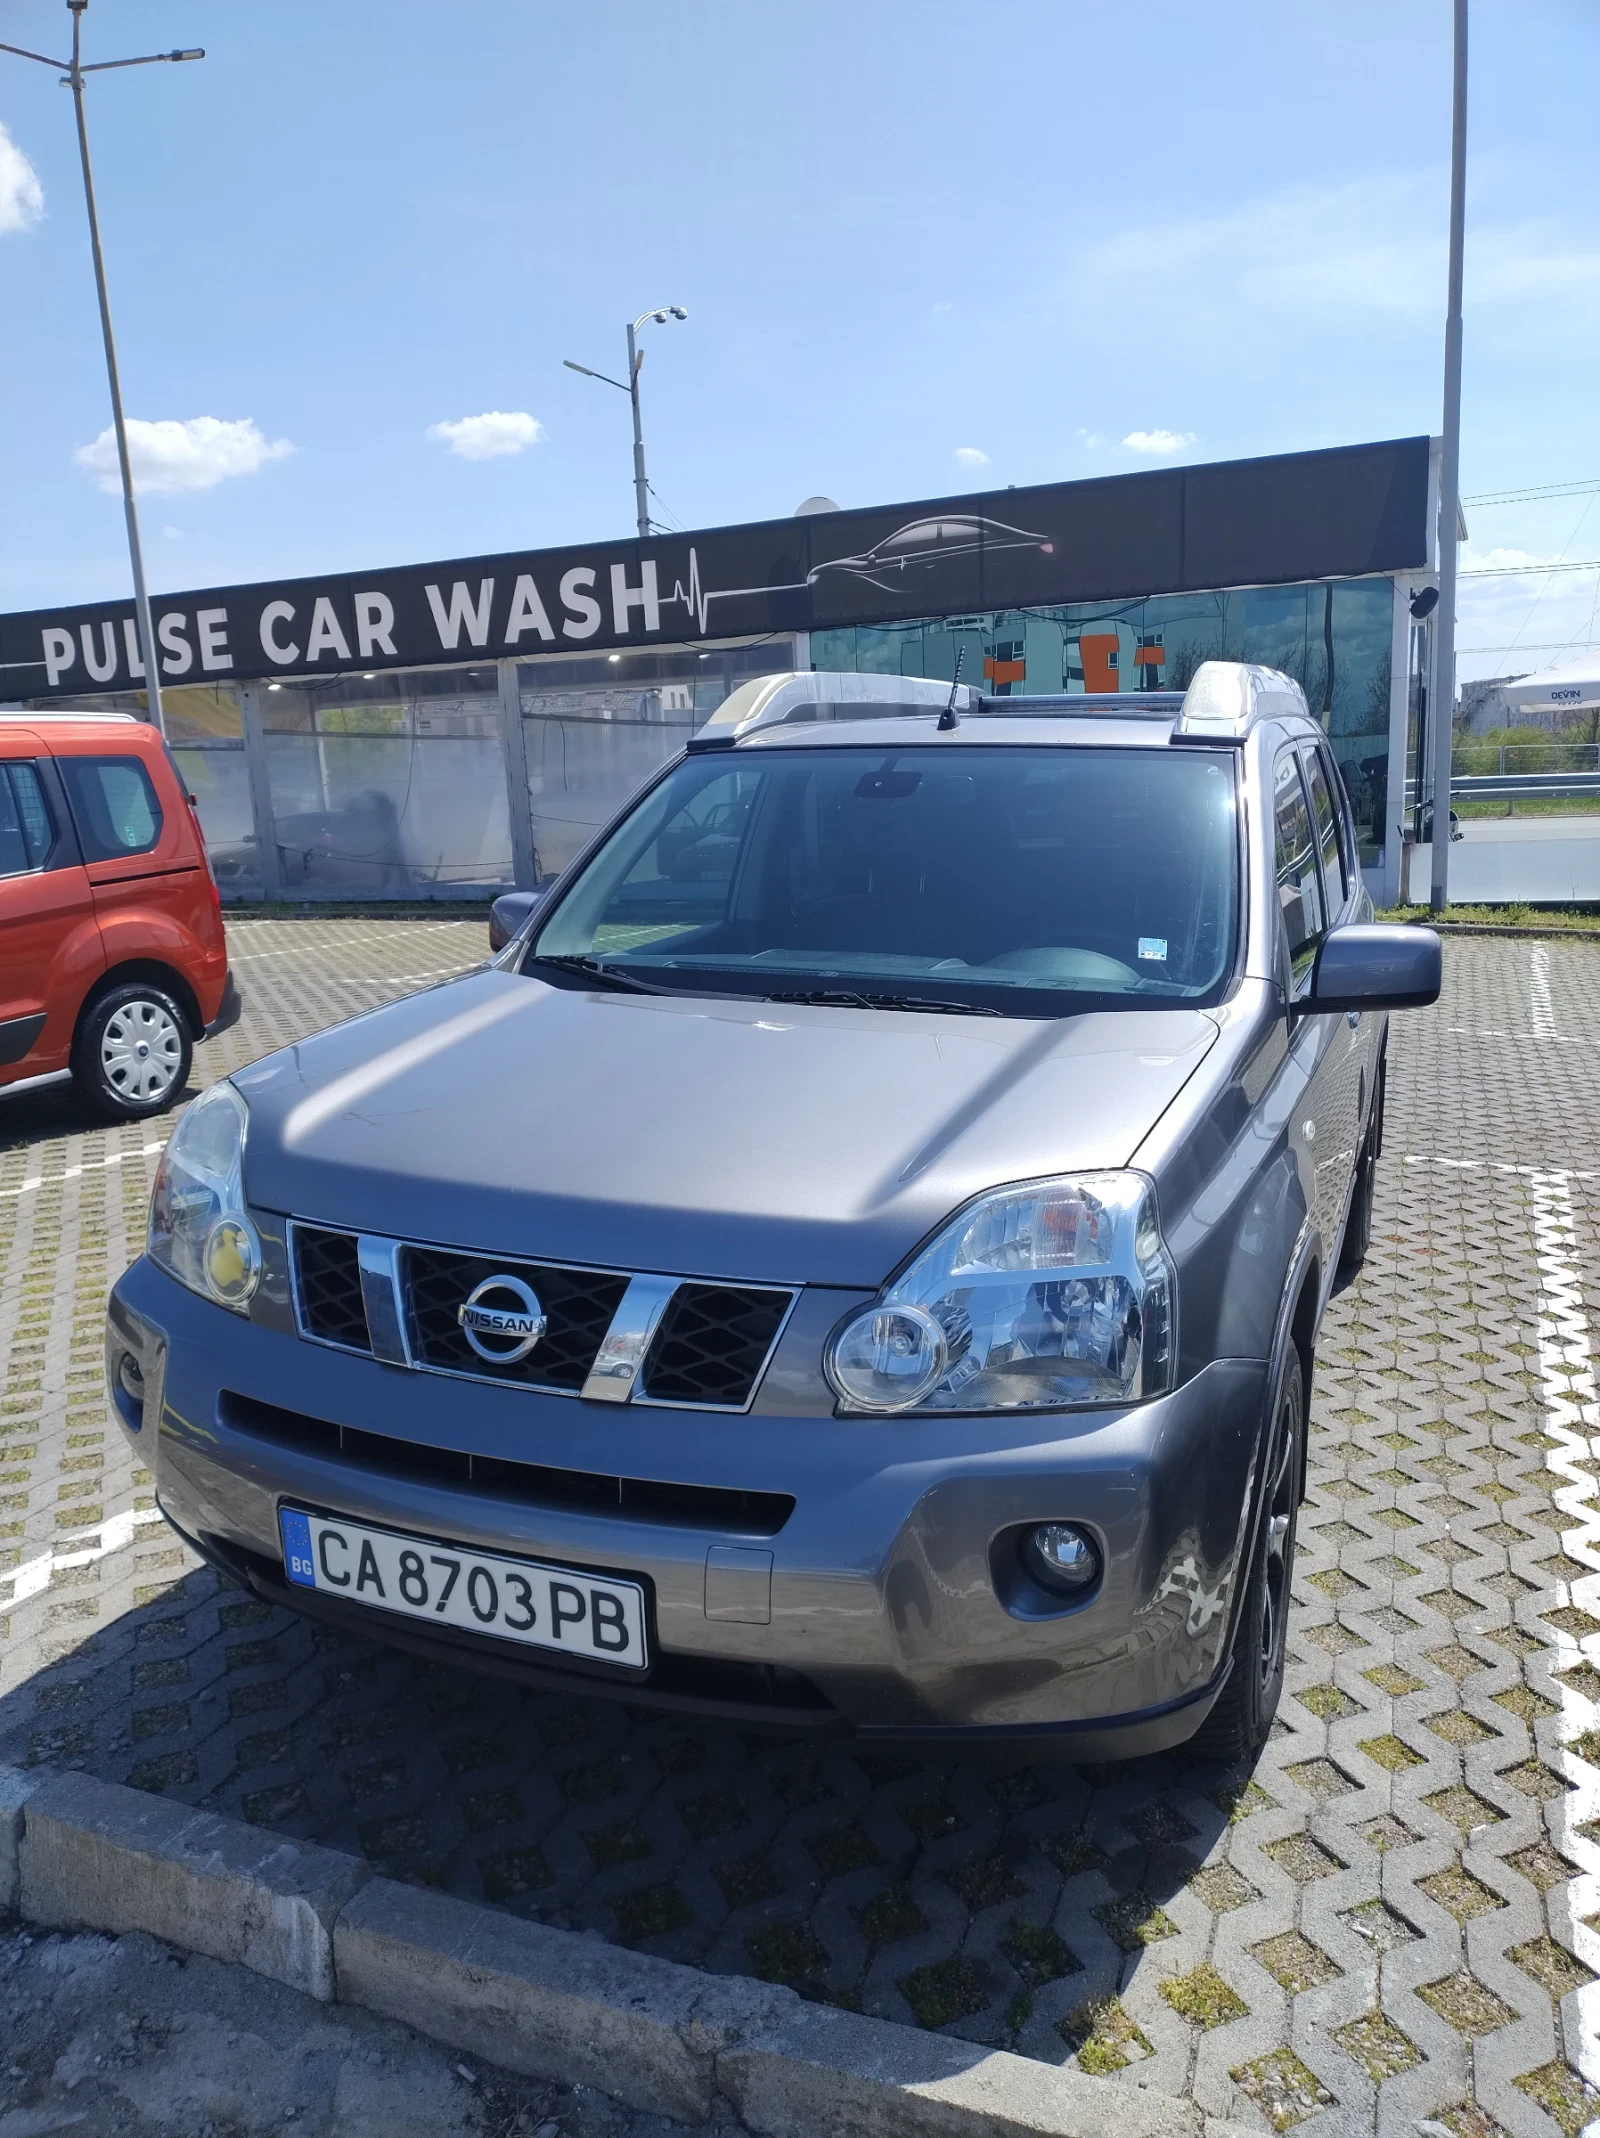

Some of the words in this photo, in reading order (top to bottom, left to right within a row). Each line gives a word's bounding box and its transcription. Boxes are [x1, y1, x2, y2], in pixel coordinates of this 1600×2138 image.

[42, 607, 234, 686] PULSE
[259, 591, 398, 666] CAR
[424, 559, 660, 650] WASH
[1551, 690, 1580, 700] DEVIN
[461, 1308, 534, 1333] NISSAN
[291, 1555, 313, 1577] BG
[317, 1529, 387, 1598] CA
[398, 1549, 537, 1632] 8703
[549, 1580, 630, 1653] PB
